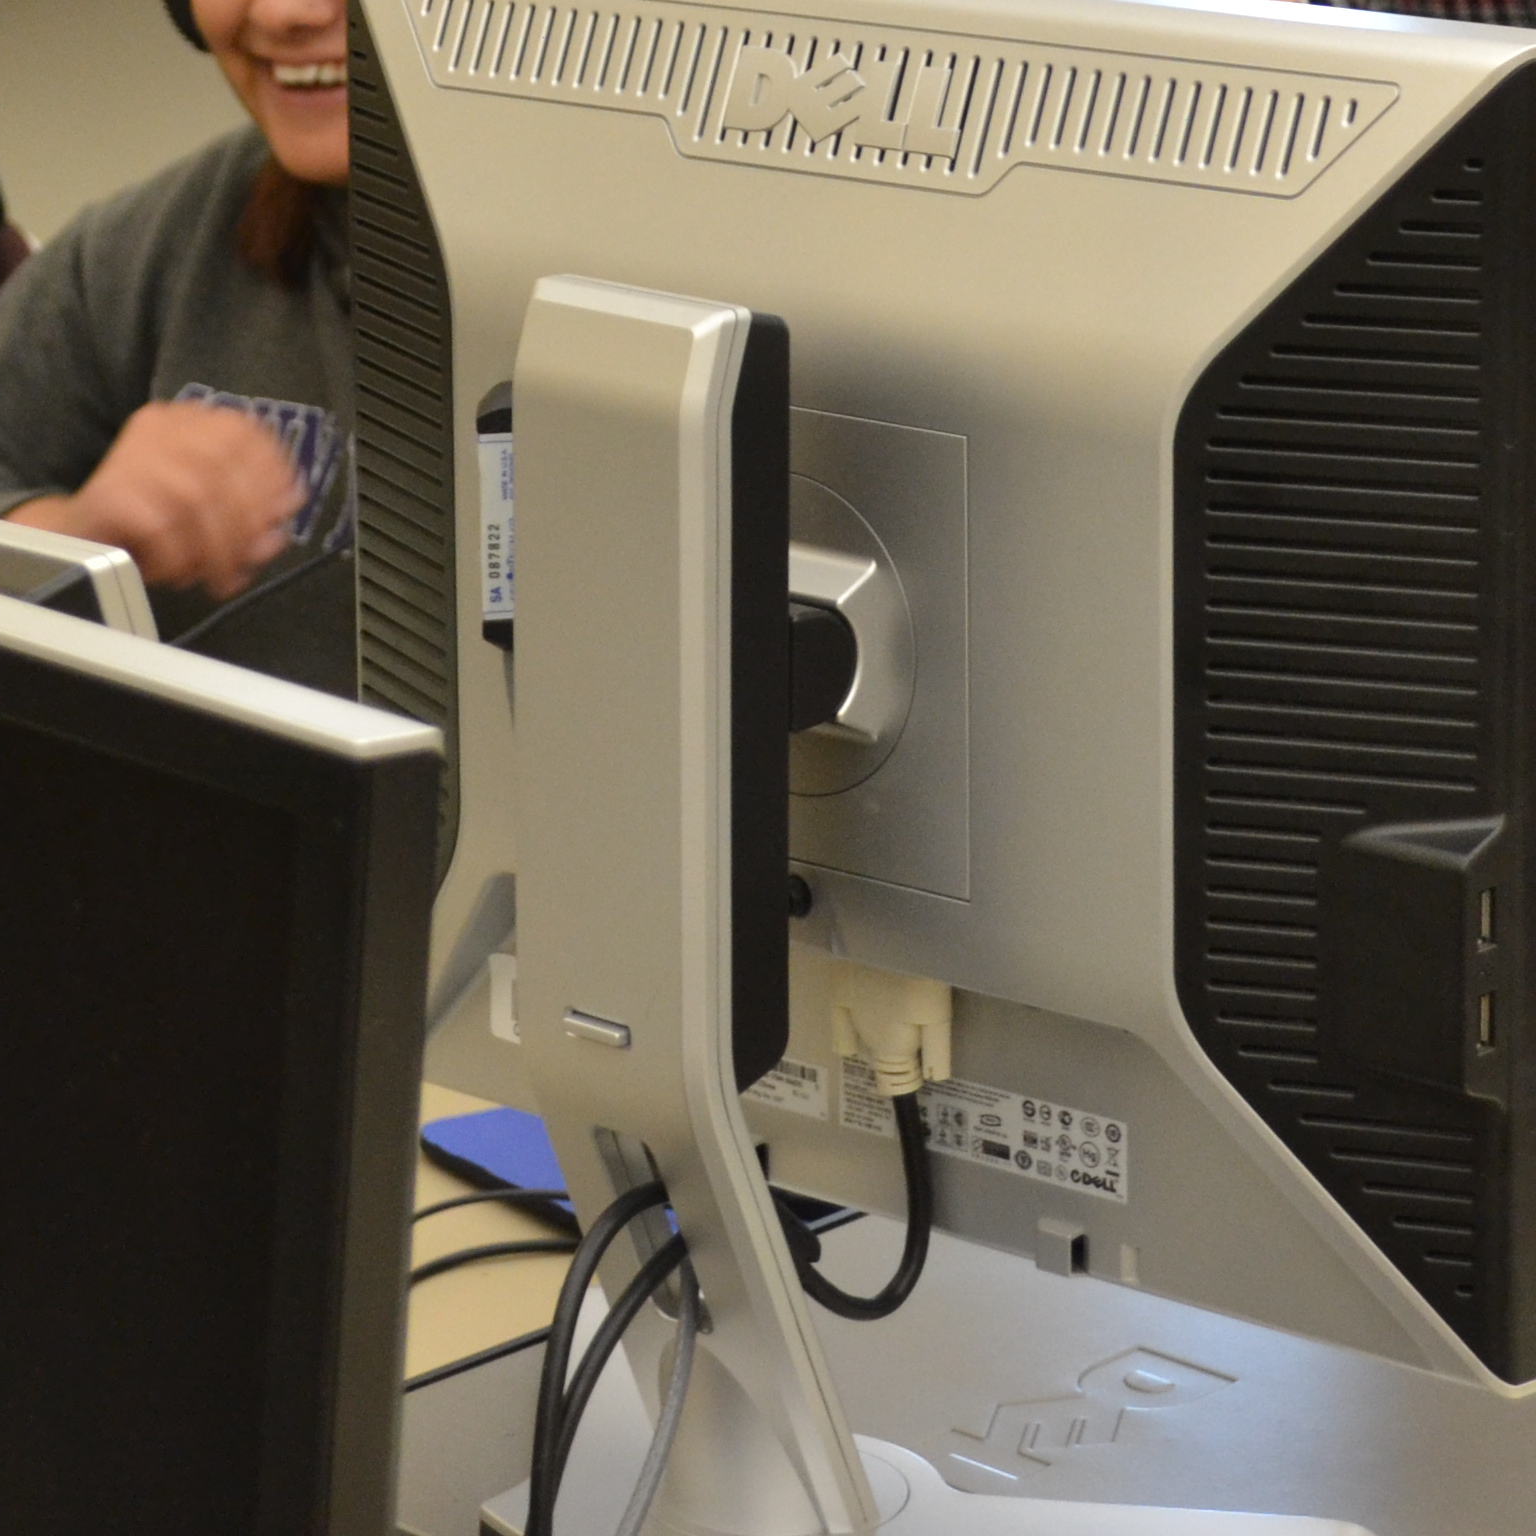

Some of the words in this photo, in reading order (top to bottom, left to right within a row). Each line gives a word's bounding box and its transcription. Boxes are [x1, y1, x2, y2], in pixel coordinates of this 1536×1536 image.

[720, 42, 962, 159] DELL
[487, 523, 501, 579] 087822
[489, 586, 502, 603] SA
